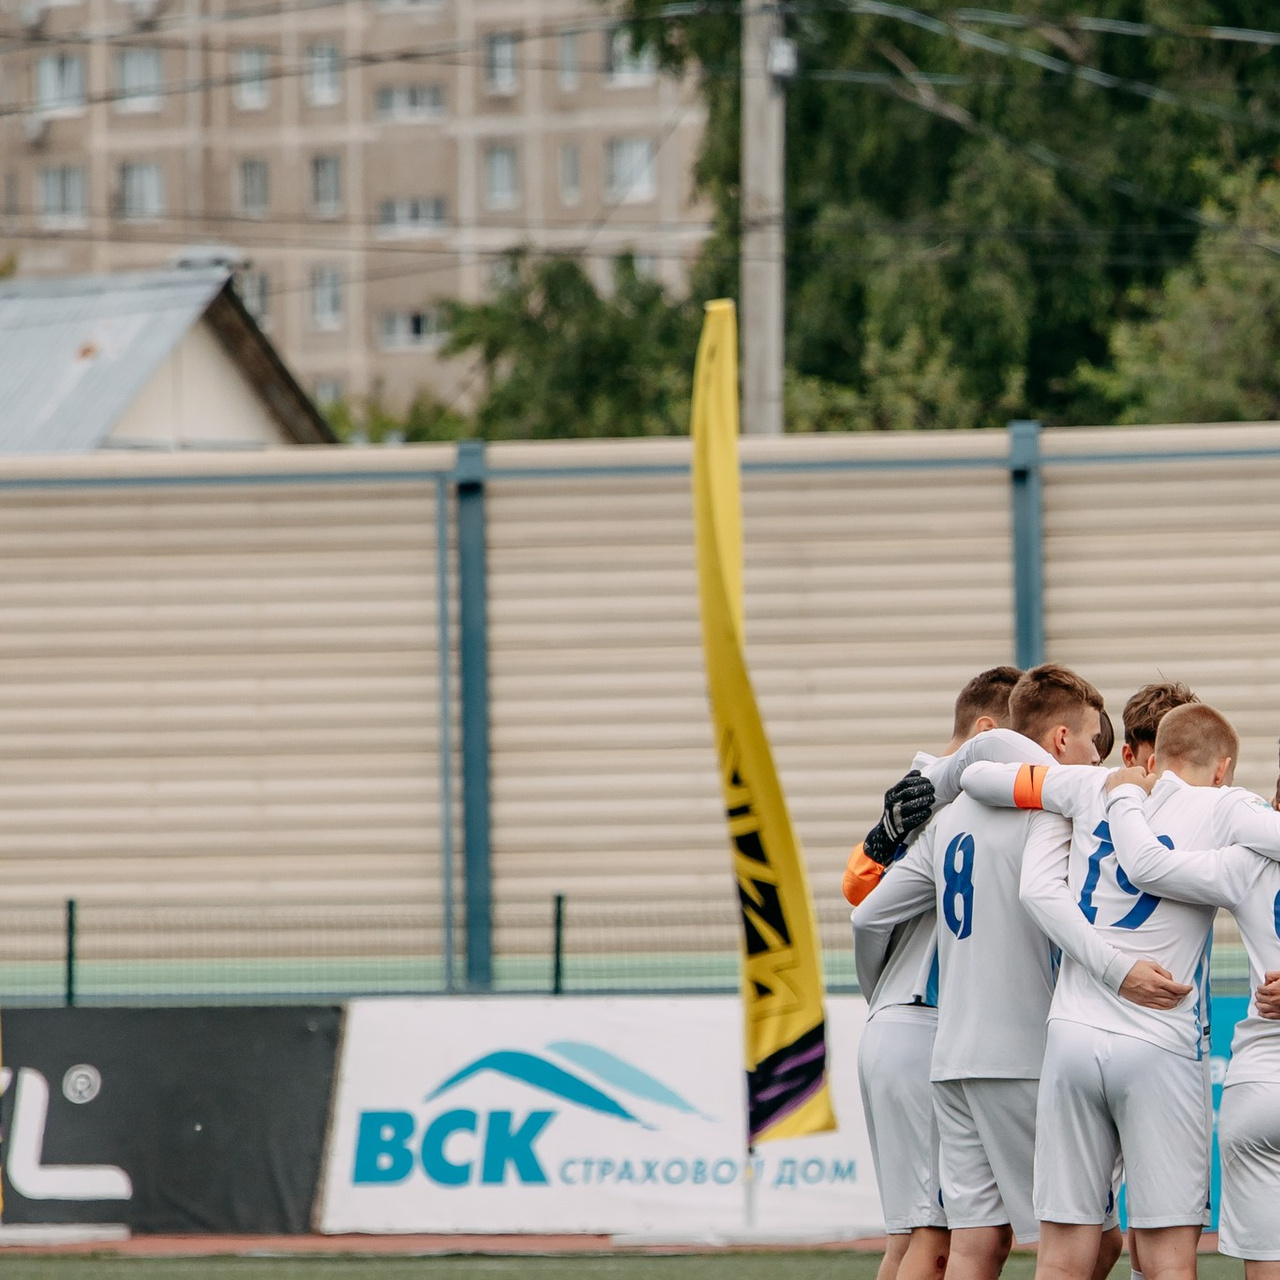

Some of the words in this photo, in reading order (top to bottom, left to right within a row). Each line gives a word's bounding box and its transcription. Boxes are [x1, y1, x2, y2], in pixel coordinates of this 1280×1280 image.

[943, 831, 975, 940] 8
[0, 1066, 133, 1200] L
[352, 1107, 560, 1189] ВСК
[773, 1157, 857, 1189] ДОМ
